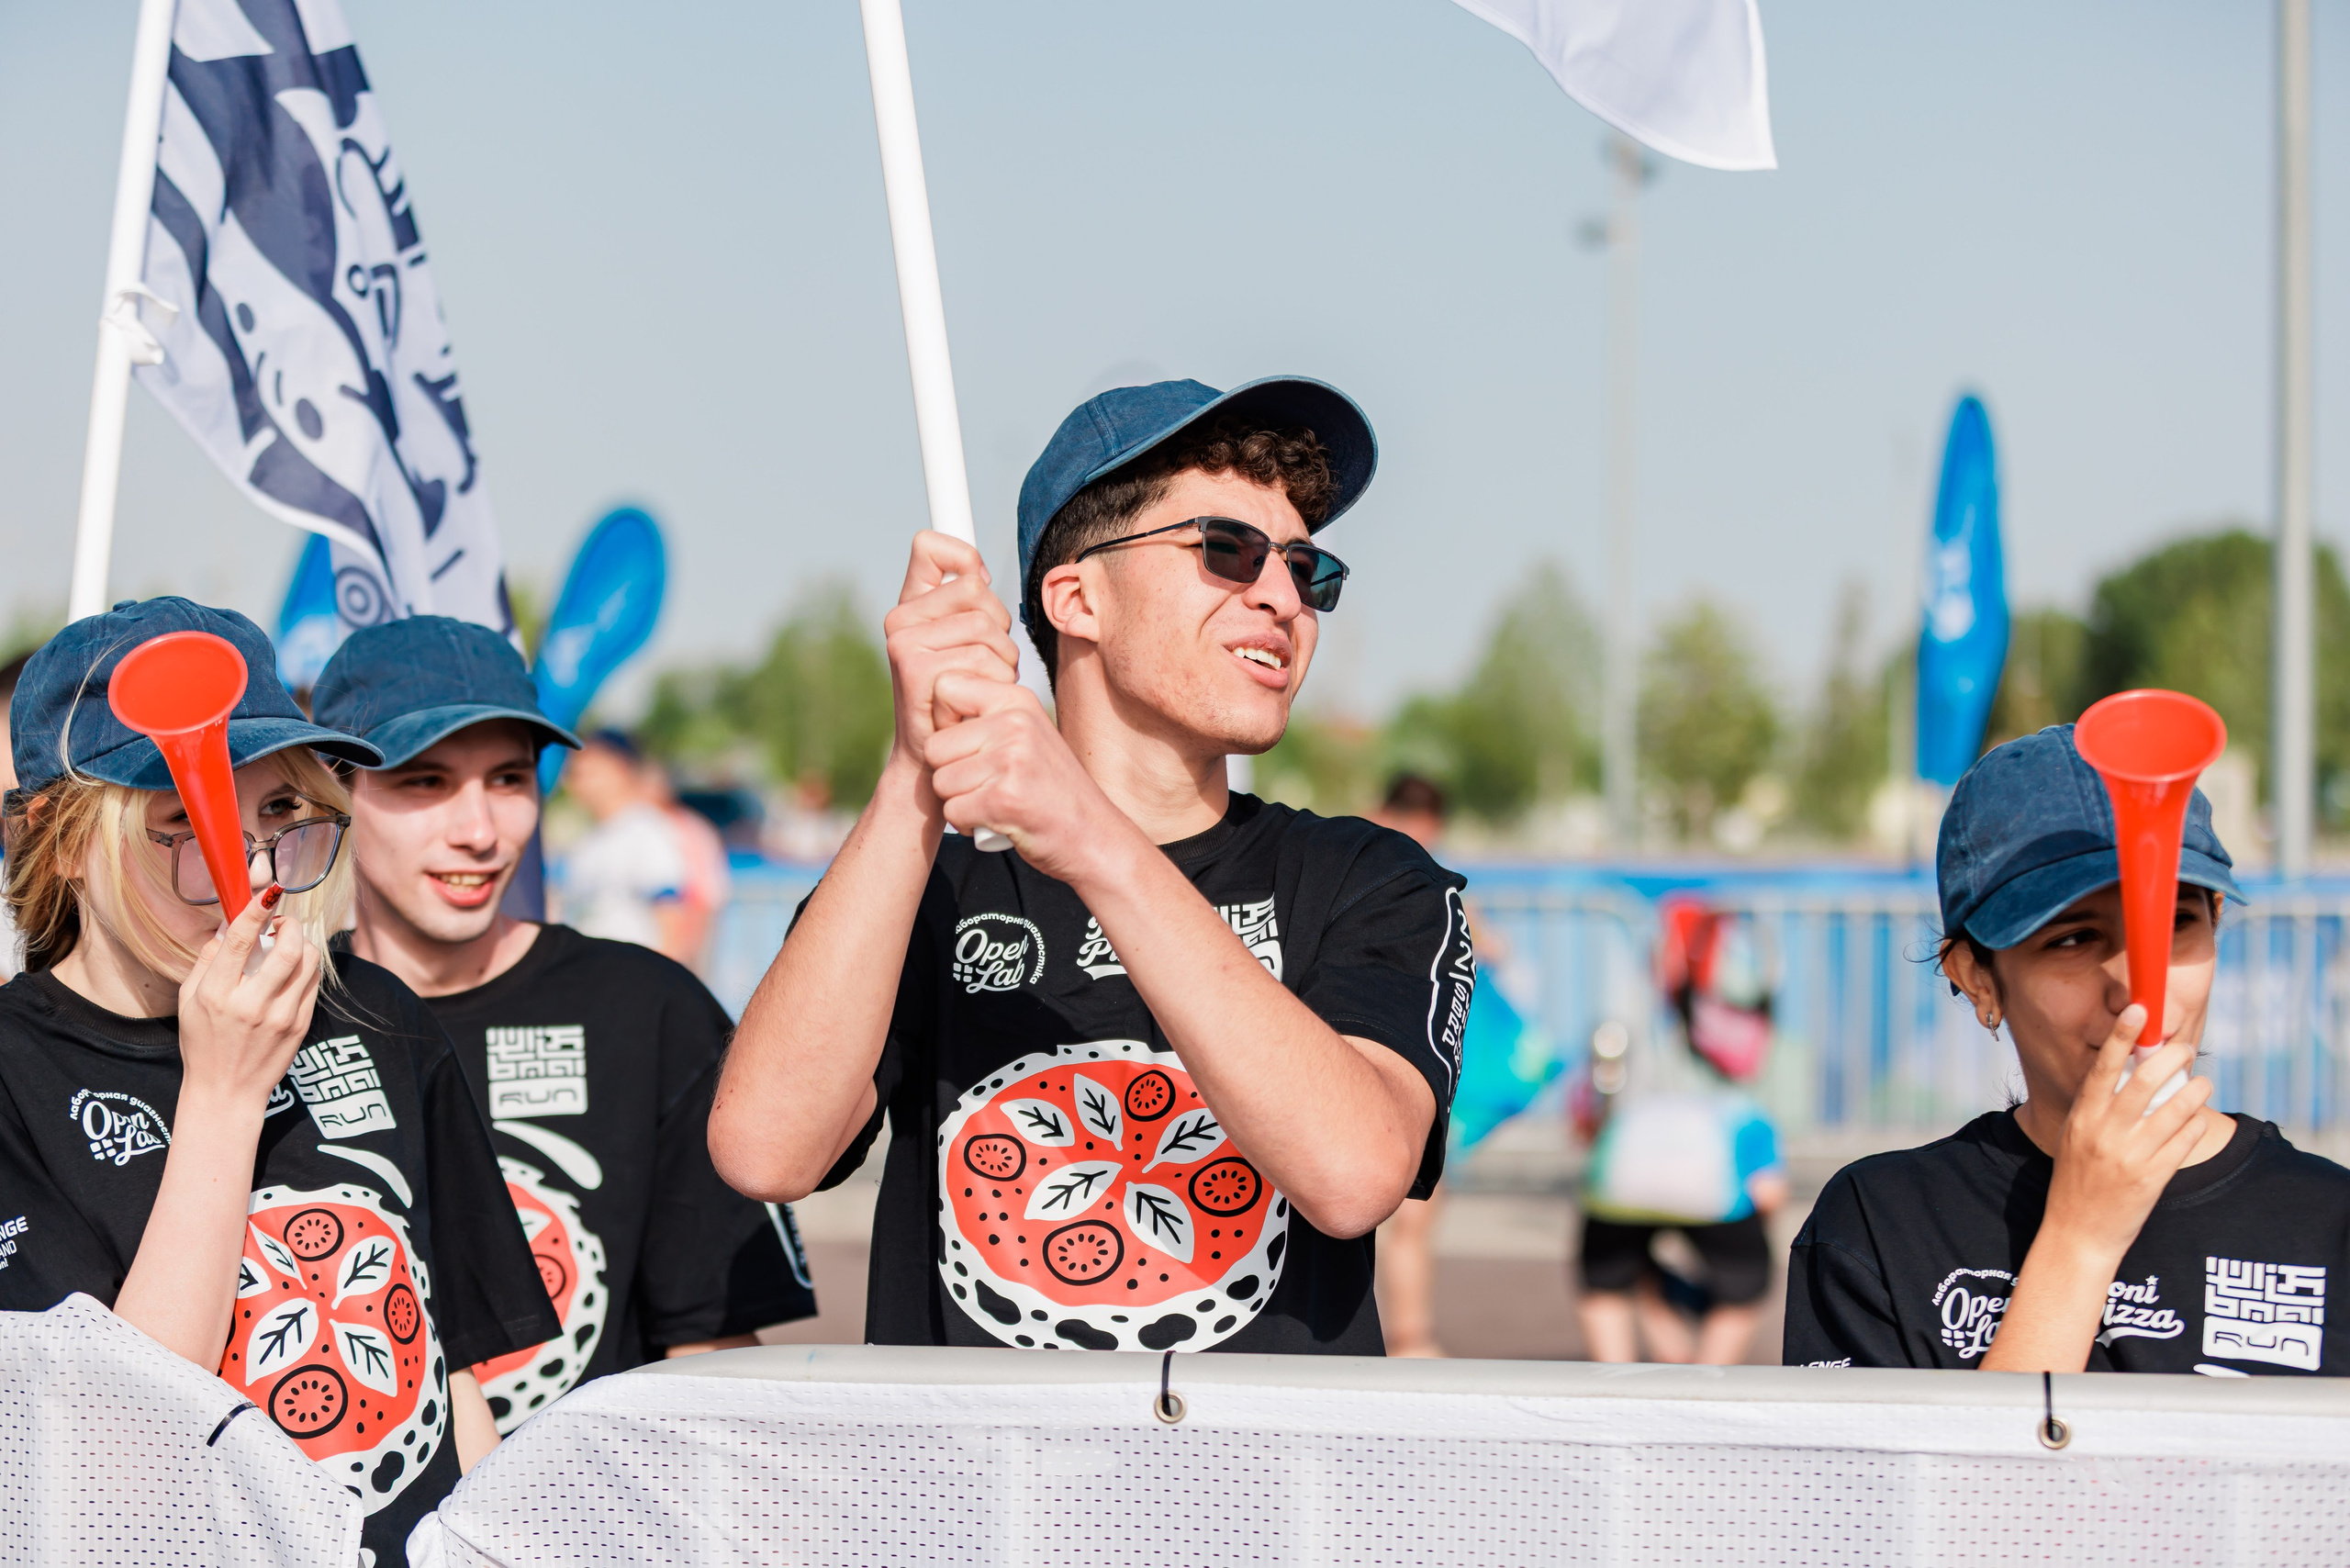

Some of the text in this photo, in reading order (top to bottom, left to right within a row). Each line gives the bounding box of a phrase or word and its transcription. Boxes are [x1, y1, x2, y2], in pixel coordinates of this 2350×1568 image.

[966, 958, 1025, 994] Lab
[2107, 1275, 2160, 1305] oni
[2100, 1297, 2179, 1330] izza
